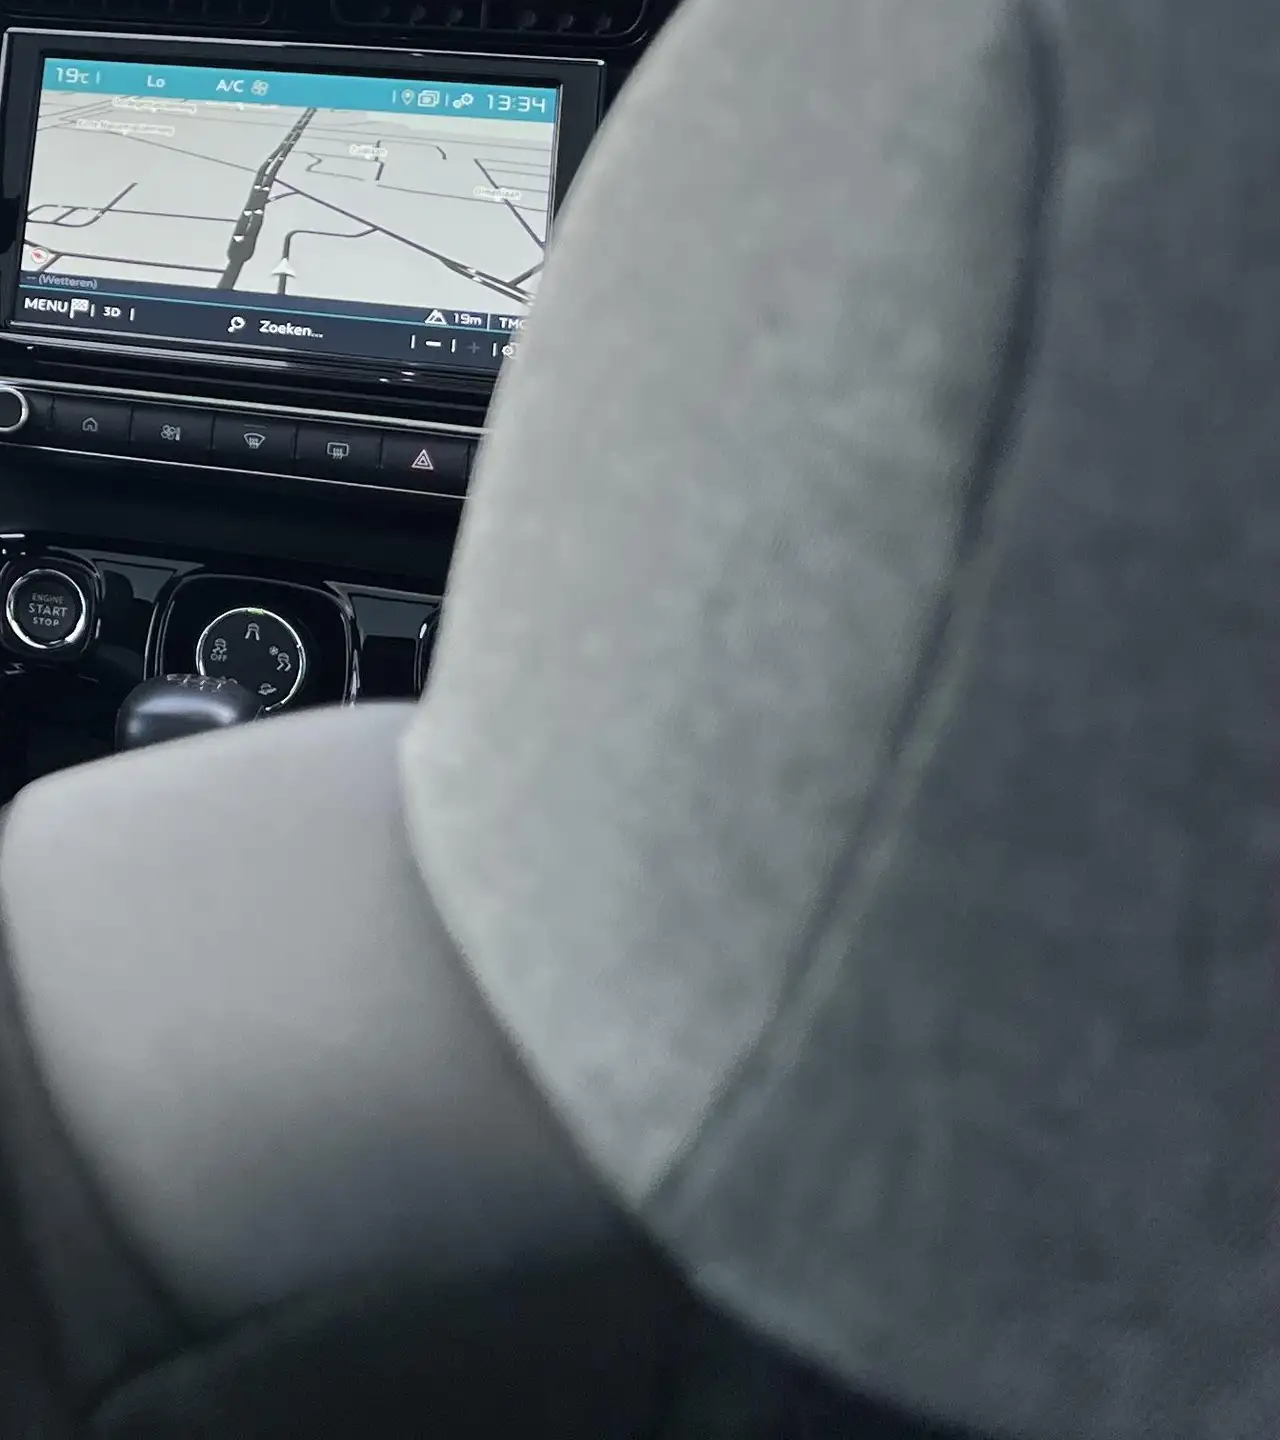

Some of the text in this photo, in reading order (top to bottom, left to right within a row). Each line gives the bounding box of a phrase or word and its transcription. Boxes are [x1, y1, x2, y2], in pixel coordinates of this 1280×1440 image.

[147, 75, 166, 88] Lo
[215, 79, 244, 92] A/C
[486, 94, 547, 114] 13:34
[38, 273, 98, 290] (Wetteren)
[24, 297, 121, 317] MENU 3D
[453, 312, 482, 326] 19m
[259, 320, 324, 339] Zoeken...
[31, 592, 64, 604] ENGINE
[28, 603, 68, 616] START
[32, 617, 60, 627] STOP
